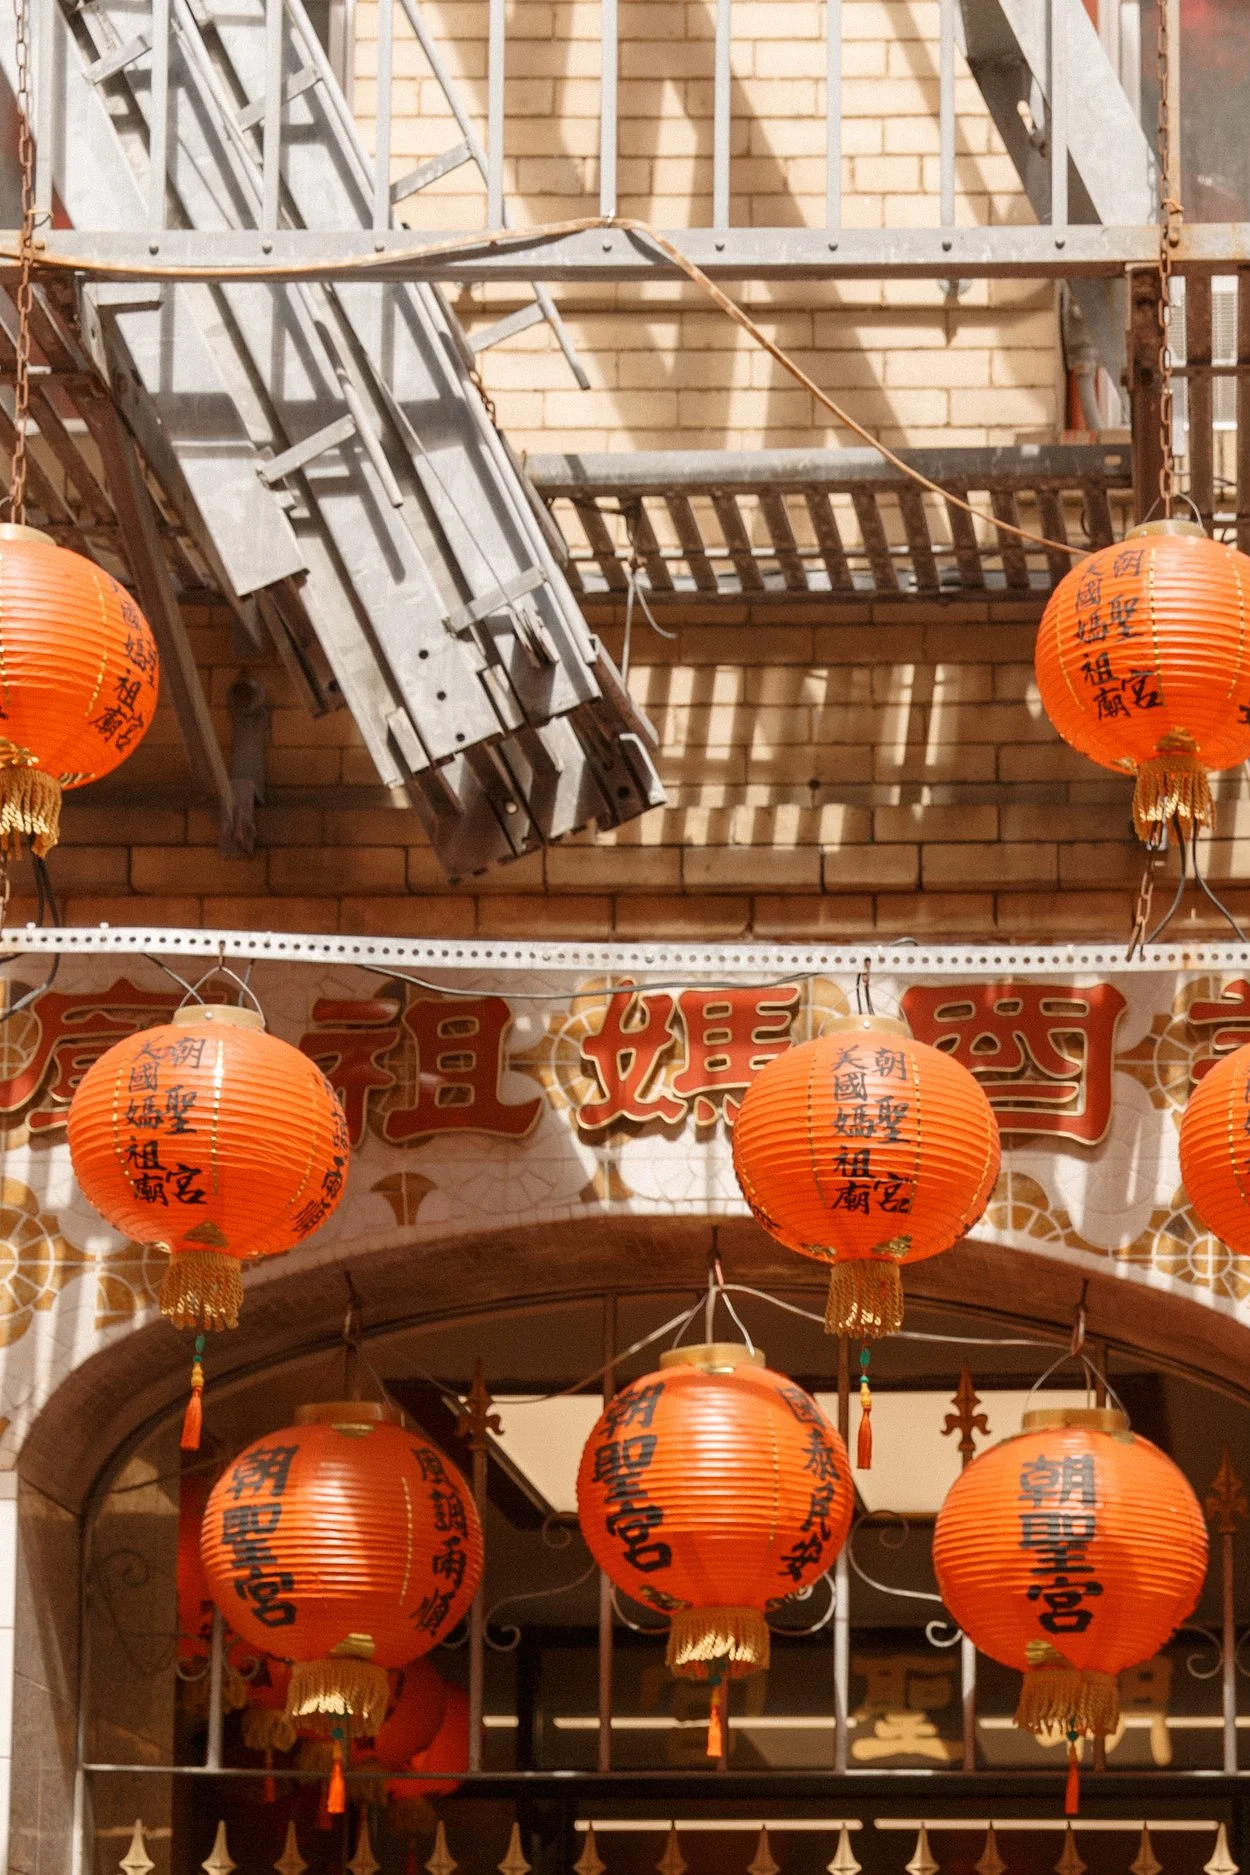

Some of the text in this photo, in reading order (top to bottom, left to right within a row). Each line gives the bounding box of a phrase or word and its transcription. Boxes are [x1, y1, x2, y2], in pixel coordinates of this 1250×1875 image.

[89, 577, 147, 743] 國媽祖廟
[1108, 549, 1165, 709] 朝聖宮
[123, 1035, 169, 1207] 美國媽祖廟
[163, 1036, 207, 1205] 朝聖宮
[832, 1045, 876, 1215] 美國媽祖廟
[873, 1047, 911, 1214] 朝聖宮
[221, 1444, 299, 1629] 朝聖宮
[591, 1382, 673, 1573] 朝聖宮
[1018, 1454, 1104, 1635] 朝聖宮
